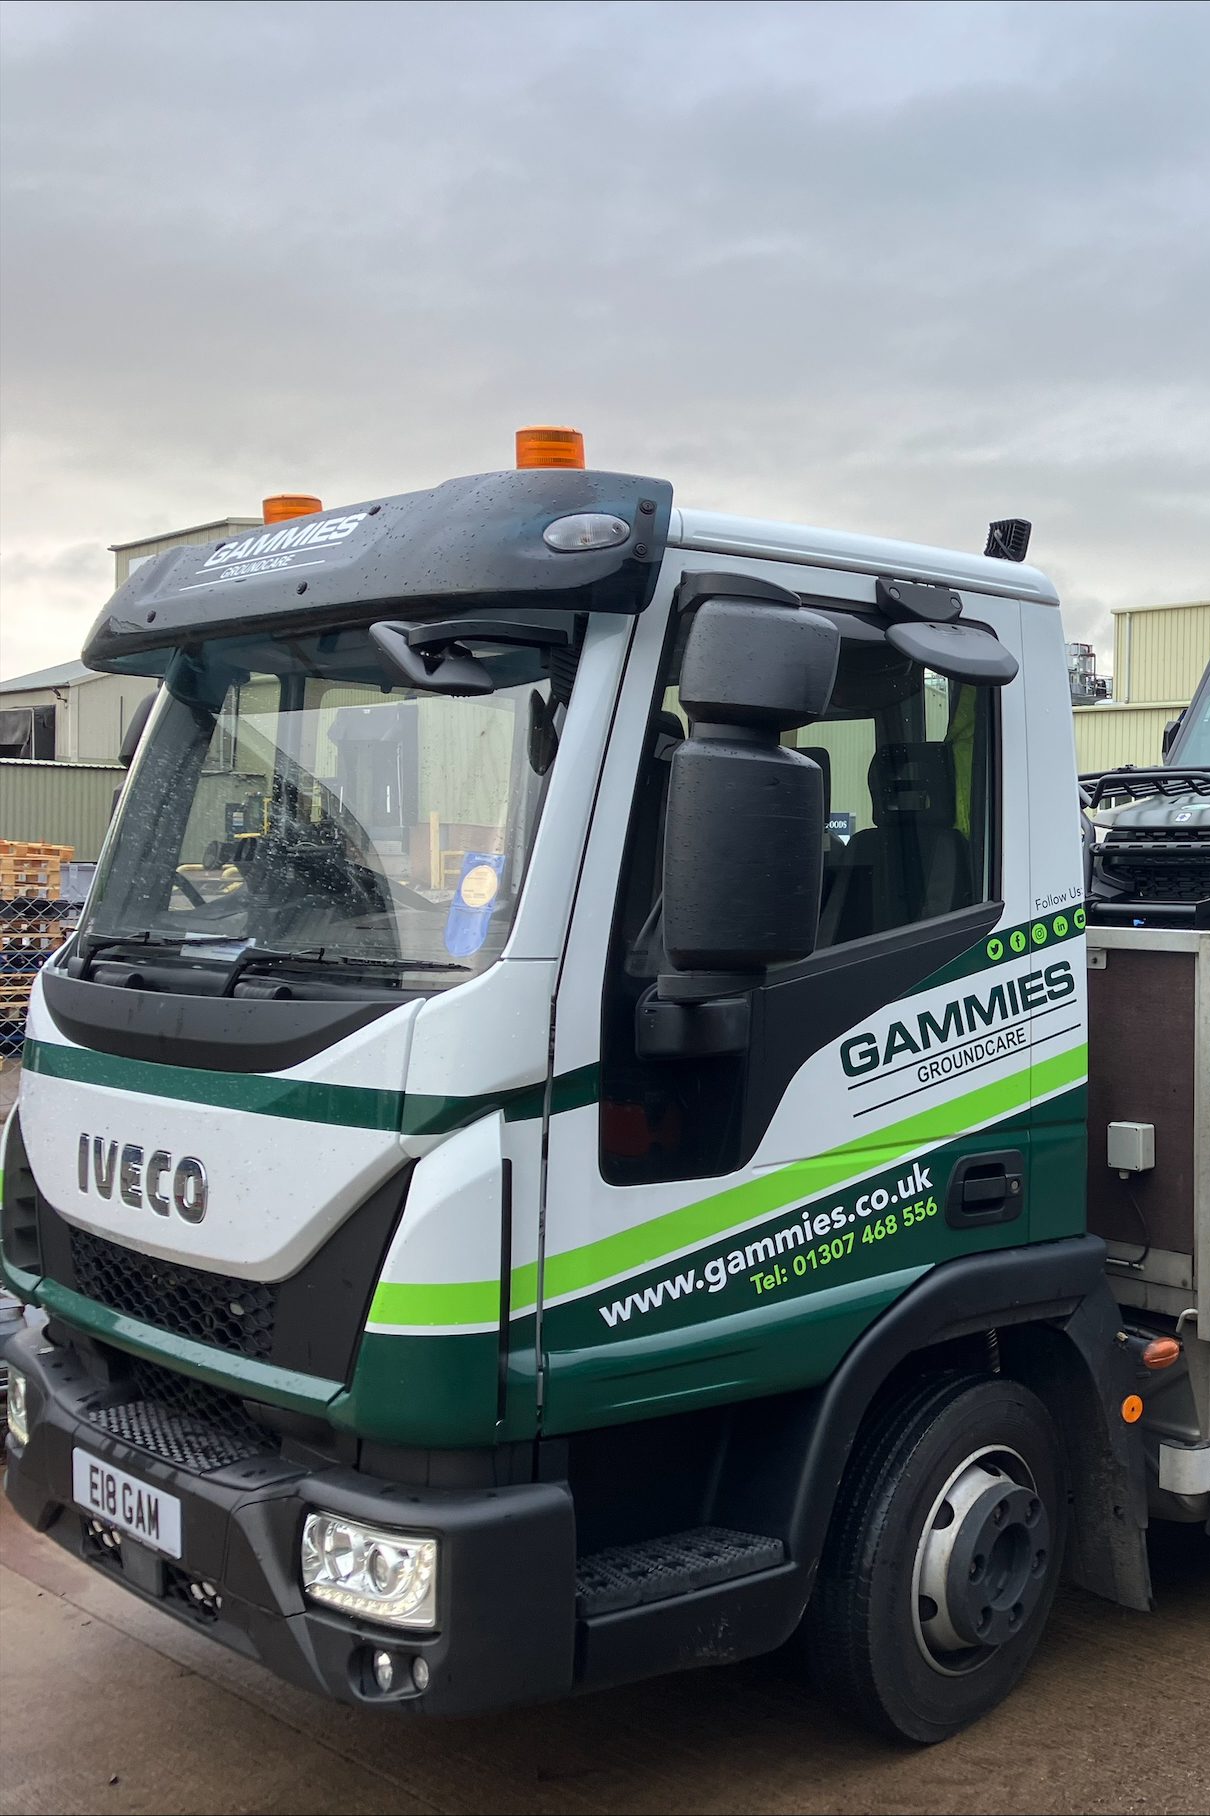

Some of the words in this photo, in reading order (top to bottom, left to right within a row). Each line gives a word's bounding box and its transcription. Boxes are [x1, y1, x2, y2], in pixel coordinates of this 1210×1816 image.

[203, 512, 368, 567] GAMMIES
[219, 554, 296, 579] GROUNDCARE
[1035, 893, 1067, 911] Follow
[1069, 887, 1084, 899] Us:
[840, 960, 1075, 1077] GAMMIES
[917, 1027, 1027, 1083] GROUNDCARE
[78, 1132, 209, 1224] IVECO
[598, 1162, 934, 1328] www.gammies.co.uk
[750, 1270, 788, 1295] Tel:
[793, 1233, 855, 1277] 01307
[861, 1214, 898, 1245] 468
[903, 1196, 938, 1228] 556
[122, 1482, 160, 1540] GAM
